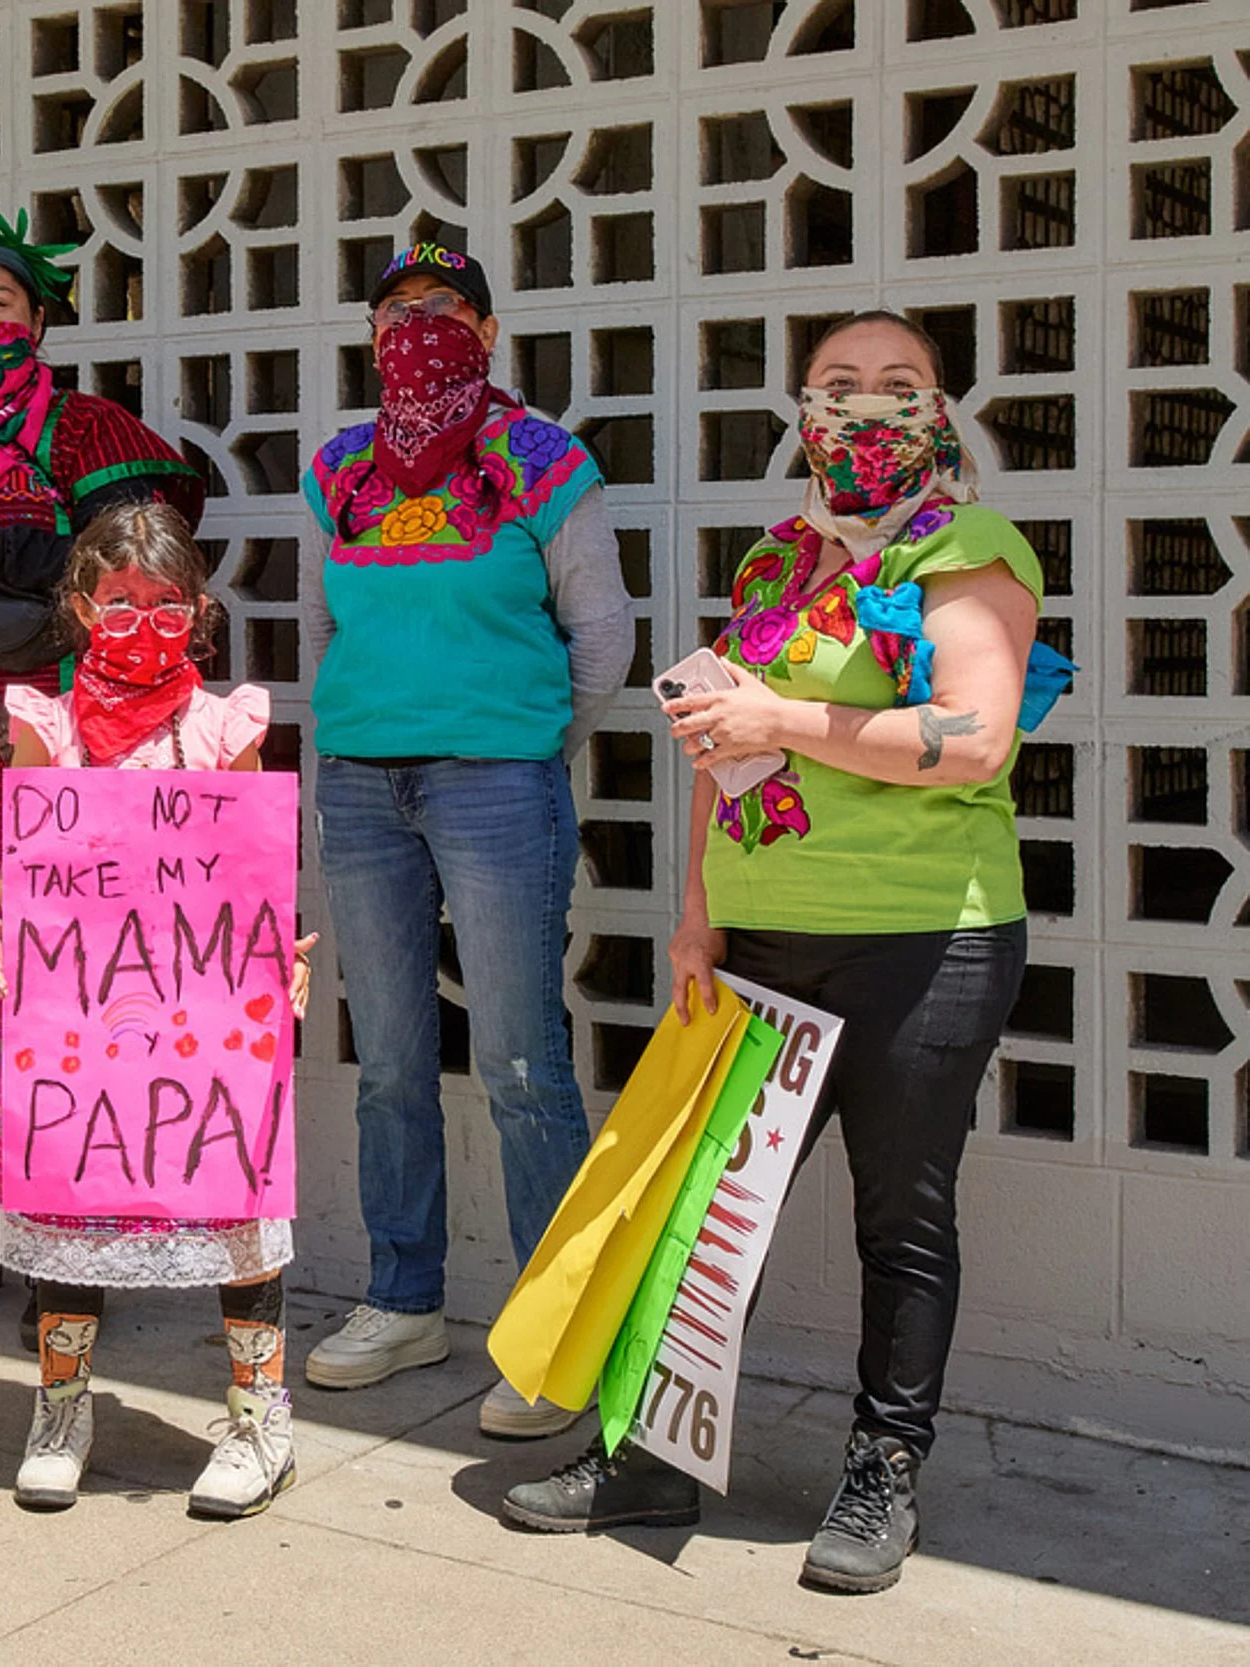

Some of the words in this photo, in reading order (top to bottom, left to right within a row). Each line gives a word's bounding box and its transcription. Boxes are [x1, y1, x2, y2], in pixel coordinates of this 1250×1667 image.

[12, 784, 79, 841] DO
[152, 785, 238, 830] NOT
[21, 860, 121, 899] TAKE
[156, 853, 220, 894] MY
[13, 898, 290, 1017] MAMA
[24, 1075, 284, 1197] PAPA!
